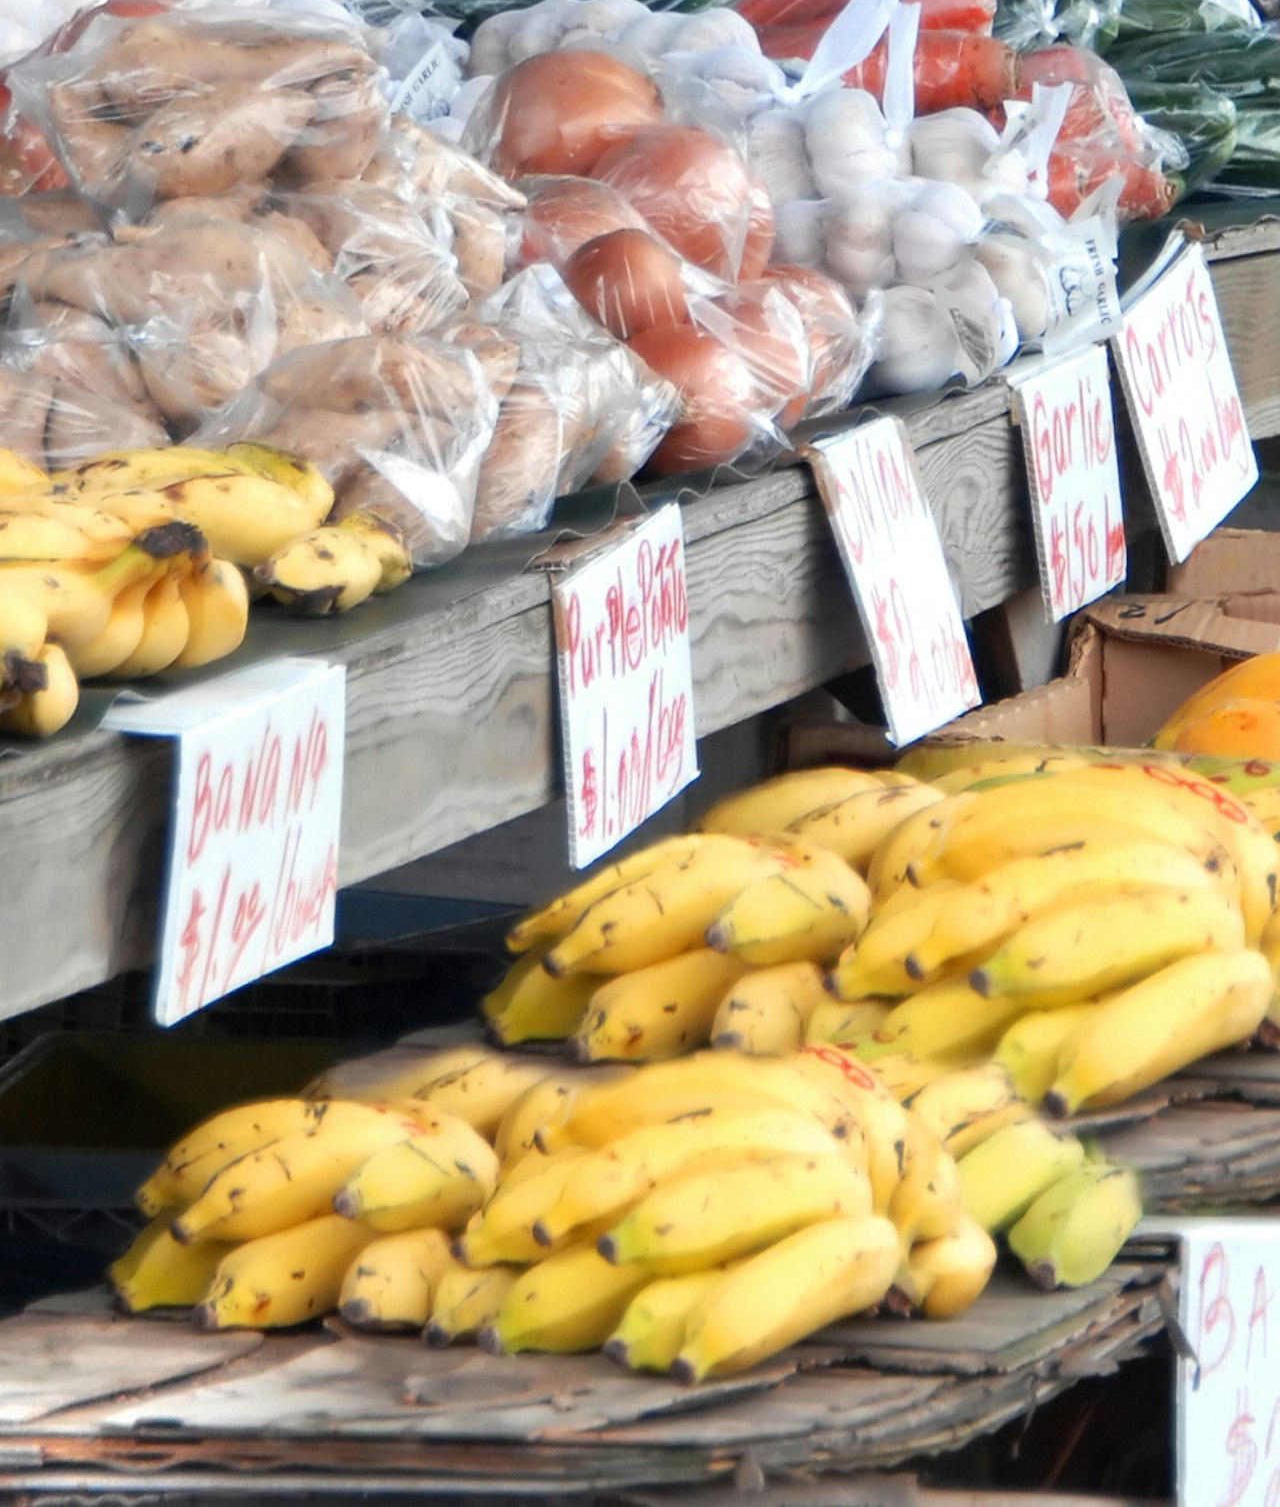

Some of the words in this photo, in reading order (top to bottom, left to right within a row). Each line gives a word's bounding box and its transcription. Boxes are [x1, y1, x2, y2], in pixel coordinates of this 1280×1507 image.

[1084, 238, 1105, 277] FRESH
[1097, 281, 1113, 326] GARLIC
[1032, 375, 1113, 506] Garlic
